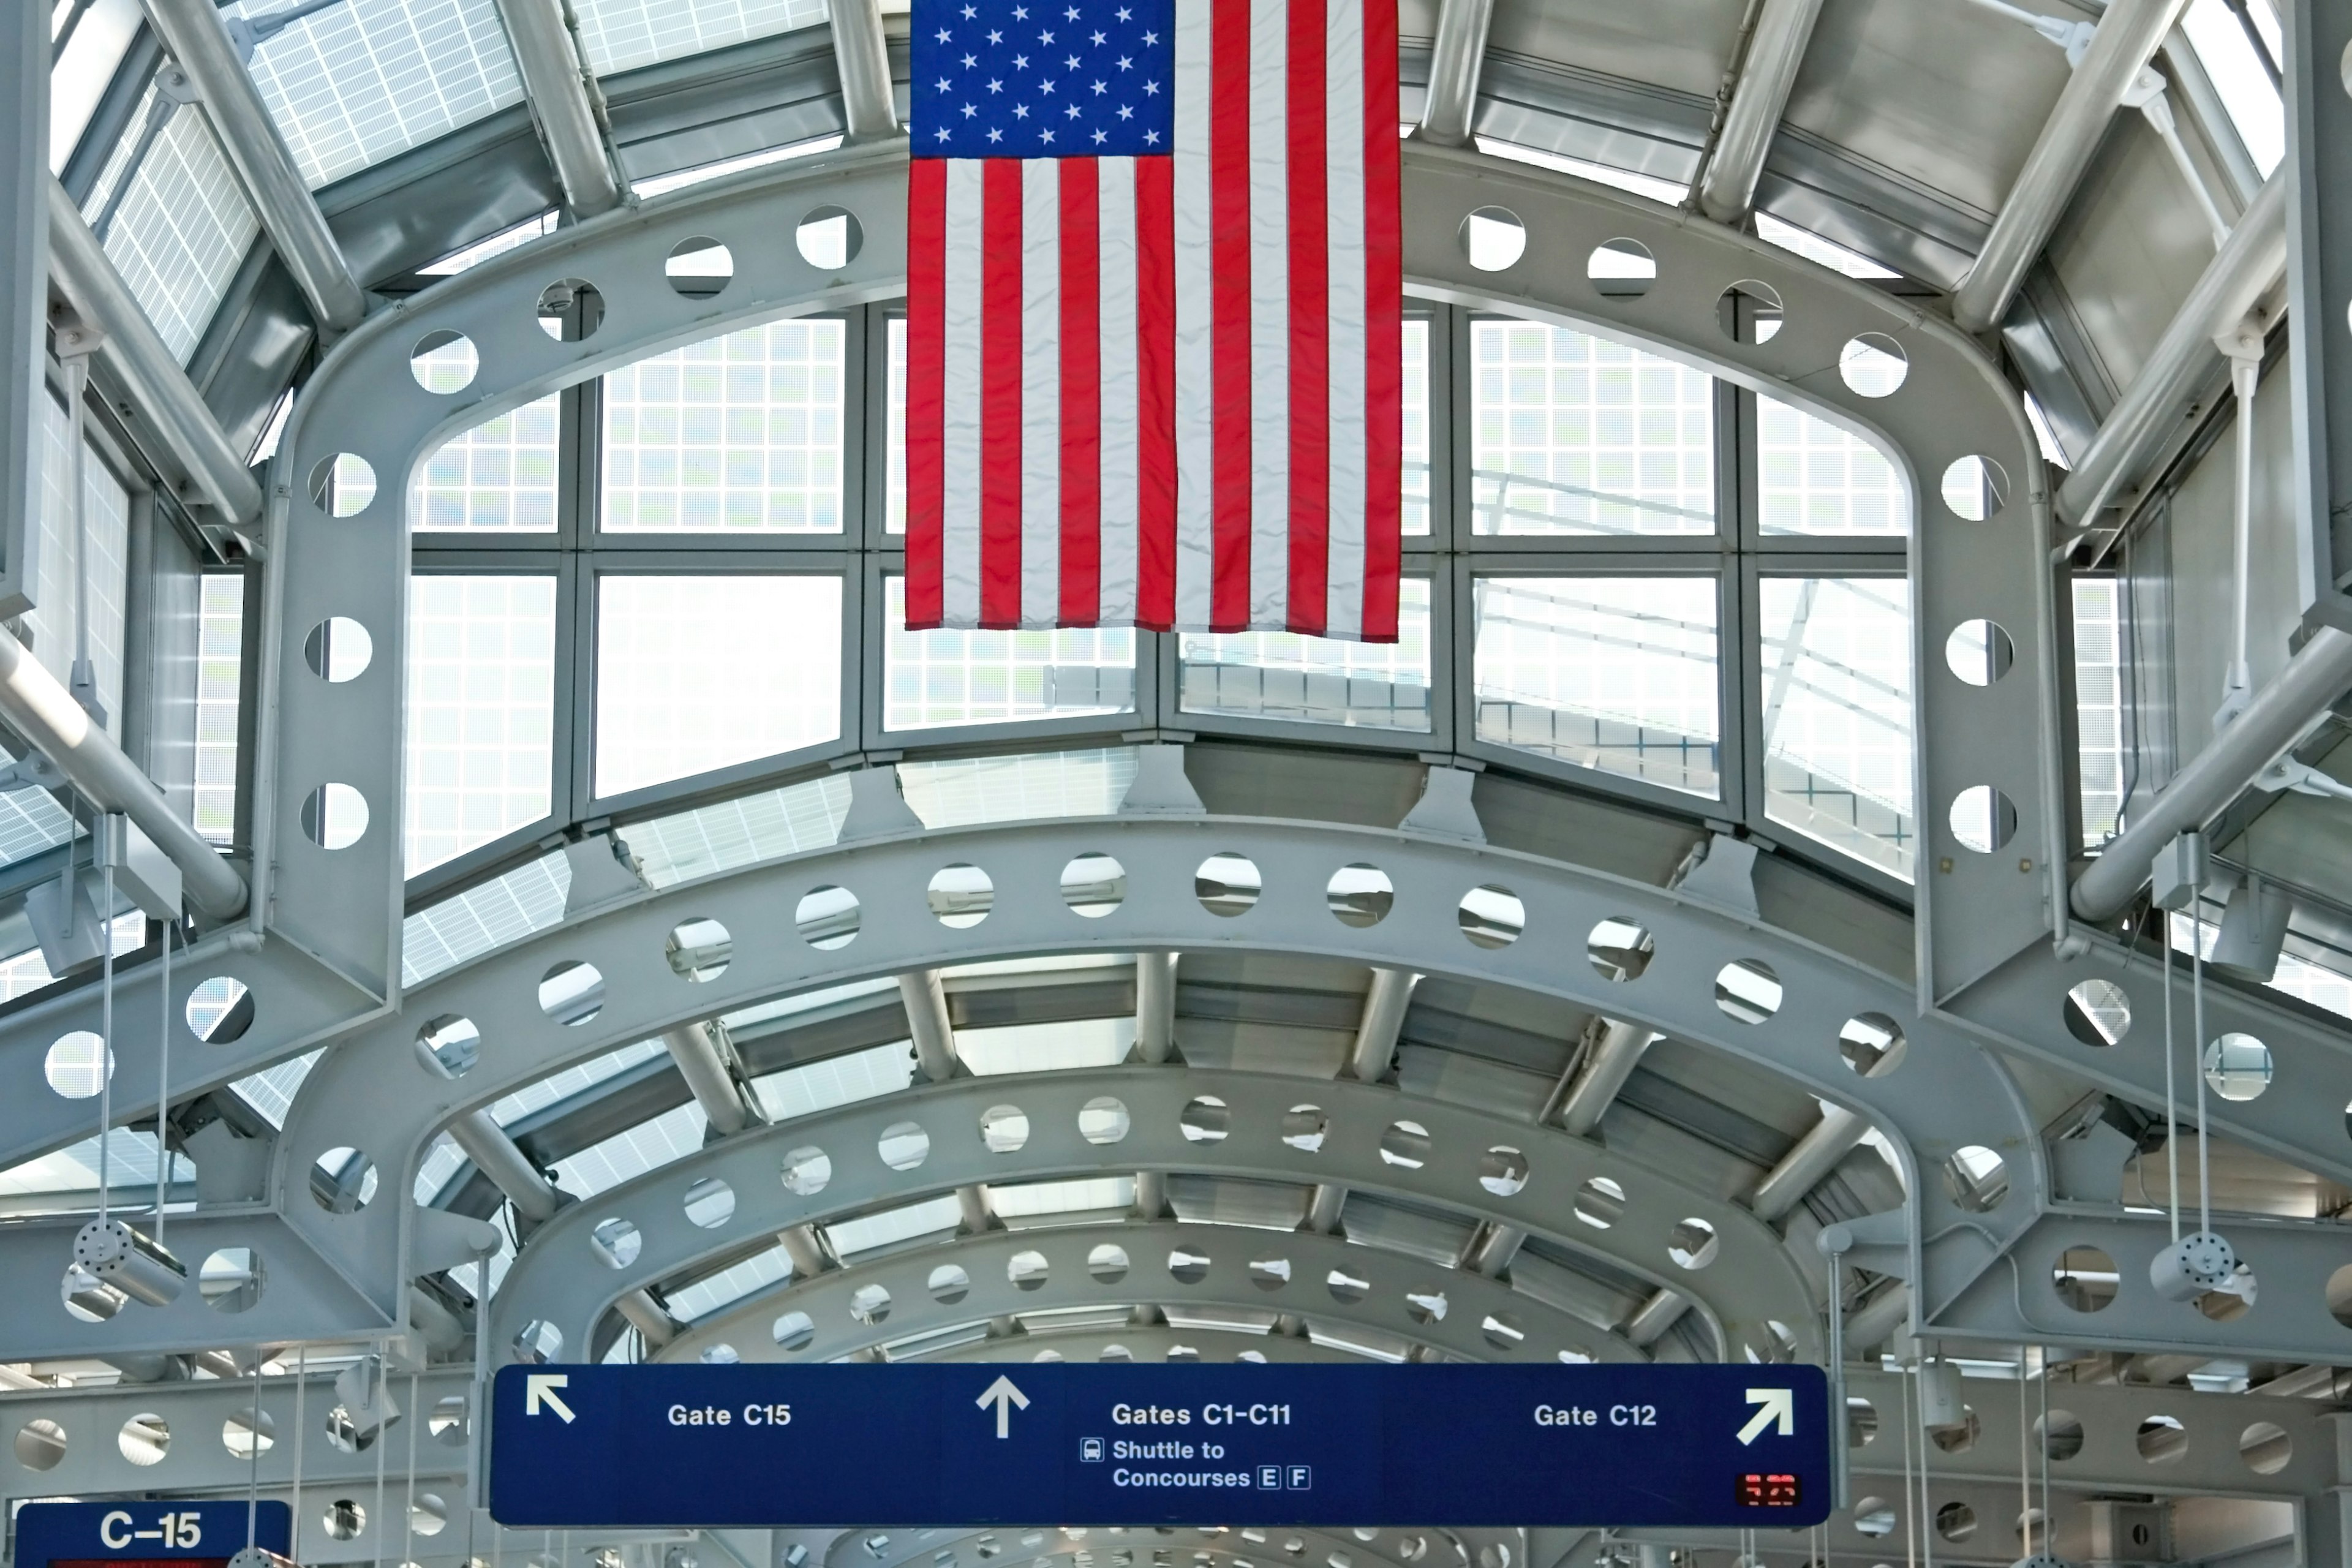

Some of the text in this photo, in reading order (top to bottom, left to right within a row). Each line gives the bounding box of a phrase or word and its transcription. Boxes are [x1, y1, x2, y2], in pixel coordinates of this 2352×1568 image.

[668, 1404, 791, 1426] Gate C15
[1112, 1403, 1290, 1425] Gates C1-C11
[1534, 1404, 1657, 1426] Gate C12
[1113, 1441, 1224, 1459] Shuttle to
[1113, 1468, 1306, 1487] Concourses E F
[100, 1510, 202, 1549] C-15
